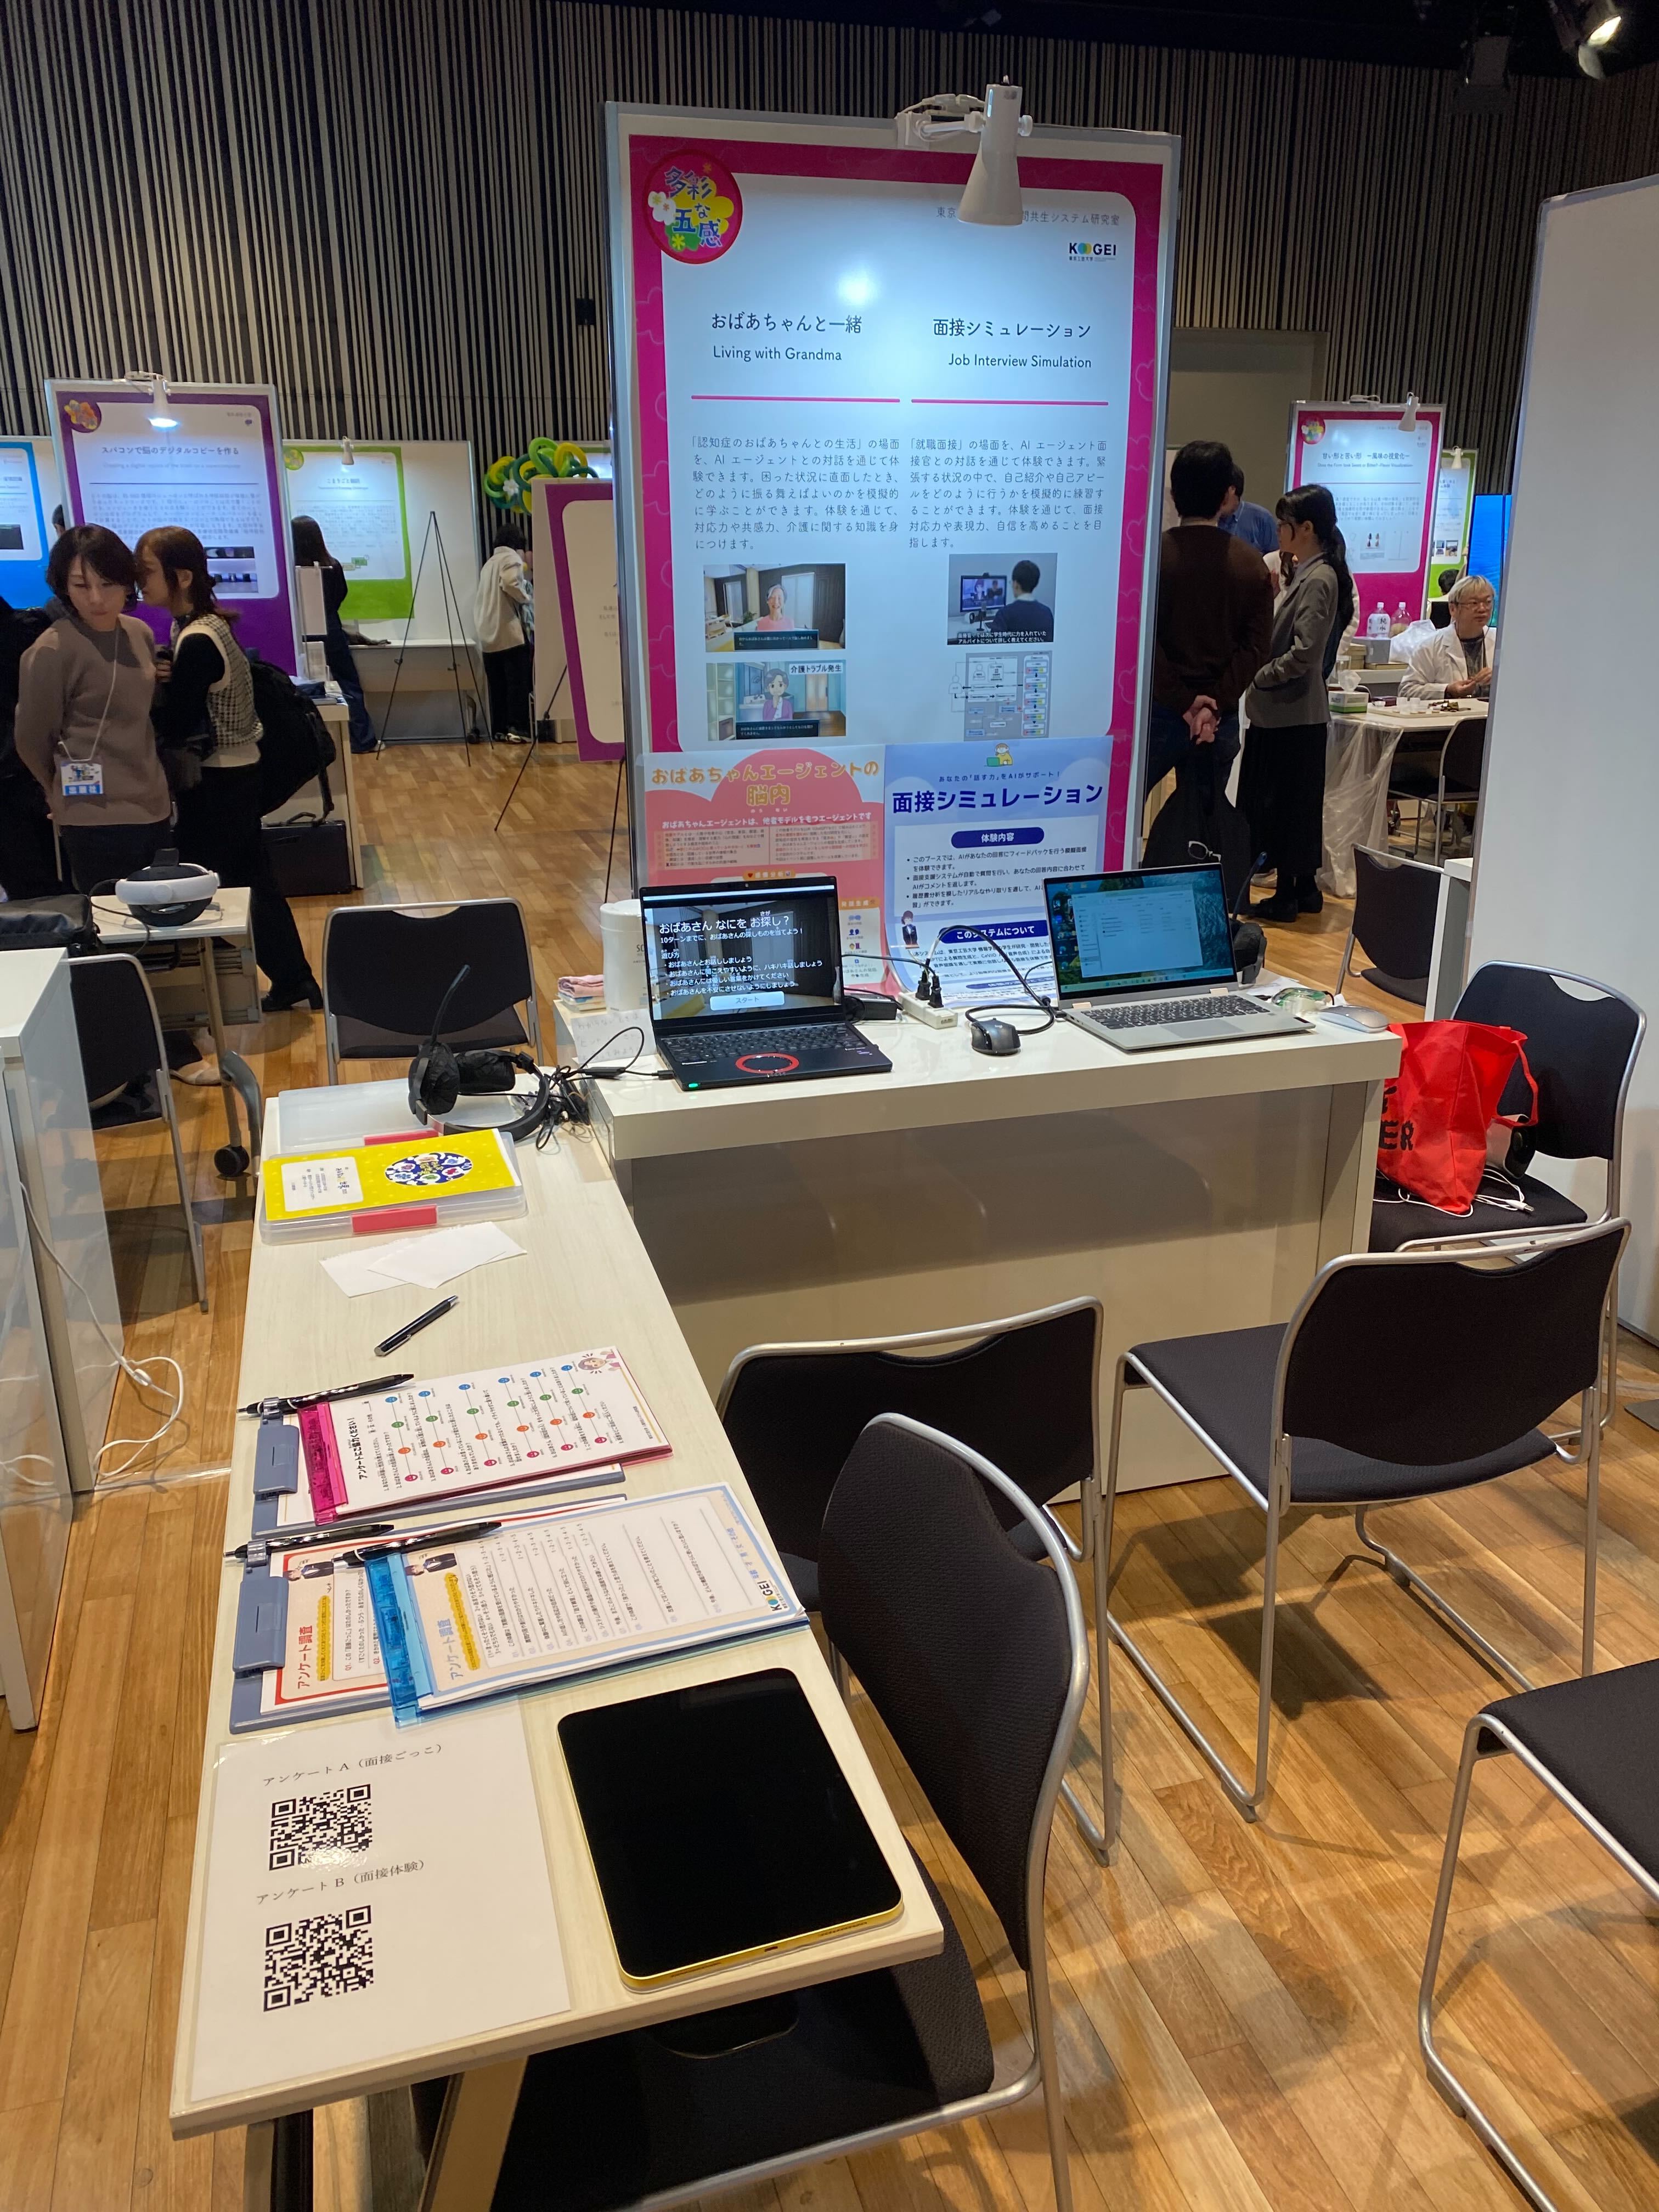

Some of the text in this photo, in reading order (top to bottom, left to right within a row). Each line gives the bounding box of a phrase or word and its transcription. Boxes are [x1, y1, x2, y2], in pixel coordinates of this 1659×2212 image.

[665, 166, 713, 200] 多彩
[695, 202, 710, 219] な
[672, 208, 723, 247] 五感
[712, 312, 862, 334] おばあちゃんと一緒
[933, 318, 1091, 338] 面接シミュレーション
[713, 346, 842, 362] Living with Grandma
[949, 354, 1092, 369] Job Interview Simulation
[696, 538, 755, 550] につけます。
[909, 537, 954, 549] 指します。
[652, 760, 879, 785] おばあちゃんエージェントの
[746, 784, 791, 806] 脳内
[892, 785, 1103, 814] 面接シミュレーション
[981, 832, 1014, 843] 体験内容
[659, 915, 789, 934] おばあさん なにを お探し？
[346, 1417, 368, 1480] アンケートにご協力ください！
[297, 1625, 312, 1689] アンケート調査
[436, 1617, 464, 1680] アンケート調査
[263, 1767, 333, 1786] アンケート
[256, 1881, 328, 1905] アンケート
